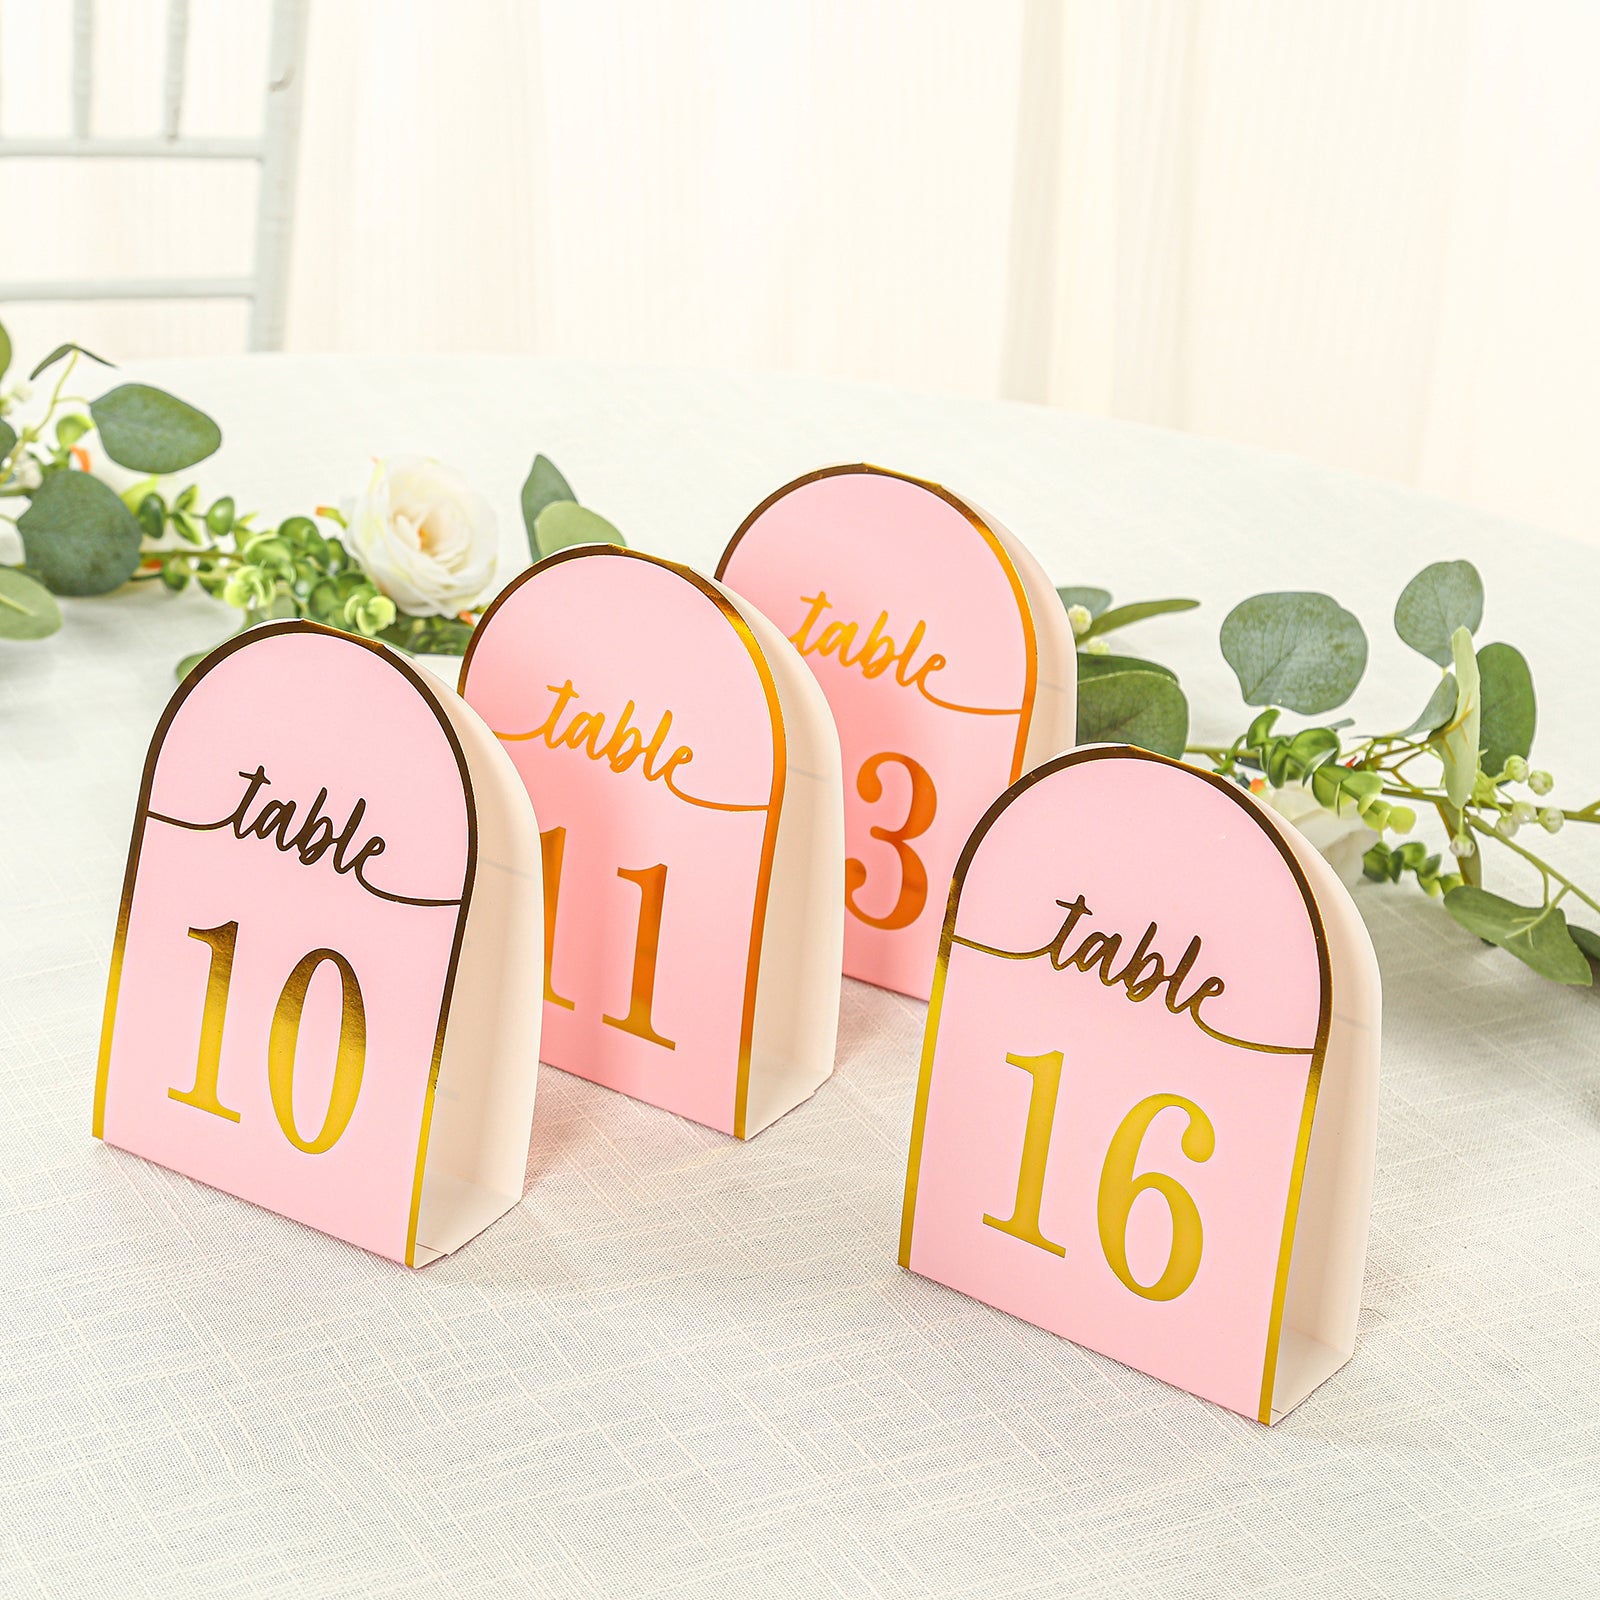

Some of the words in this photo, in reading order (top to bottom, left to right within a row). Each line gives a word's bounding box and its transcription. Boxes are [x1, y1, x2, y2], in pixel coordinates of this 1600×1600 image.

[788, 590, 952, 700] table
[538, 679, 698, 795] table
[228, 764, 392, 890] table
[1042, 894, 1232, 1030] table
[167, 920, 367, 1155] 10
[982, 1049, 1216, 1302] 16
